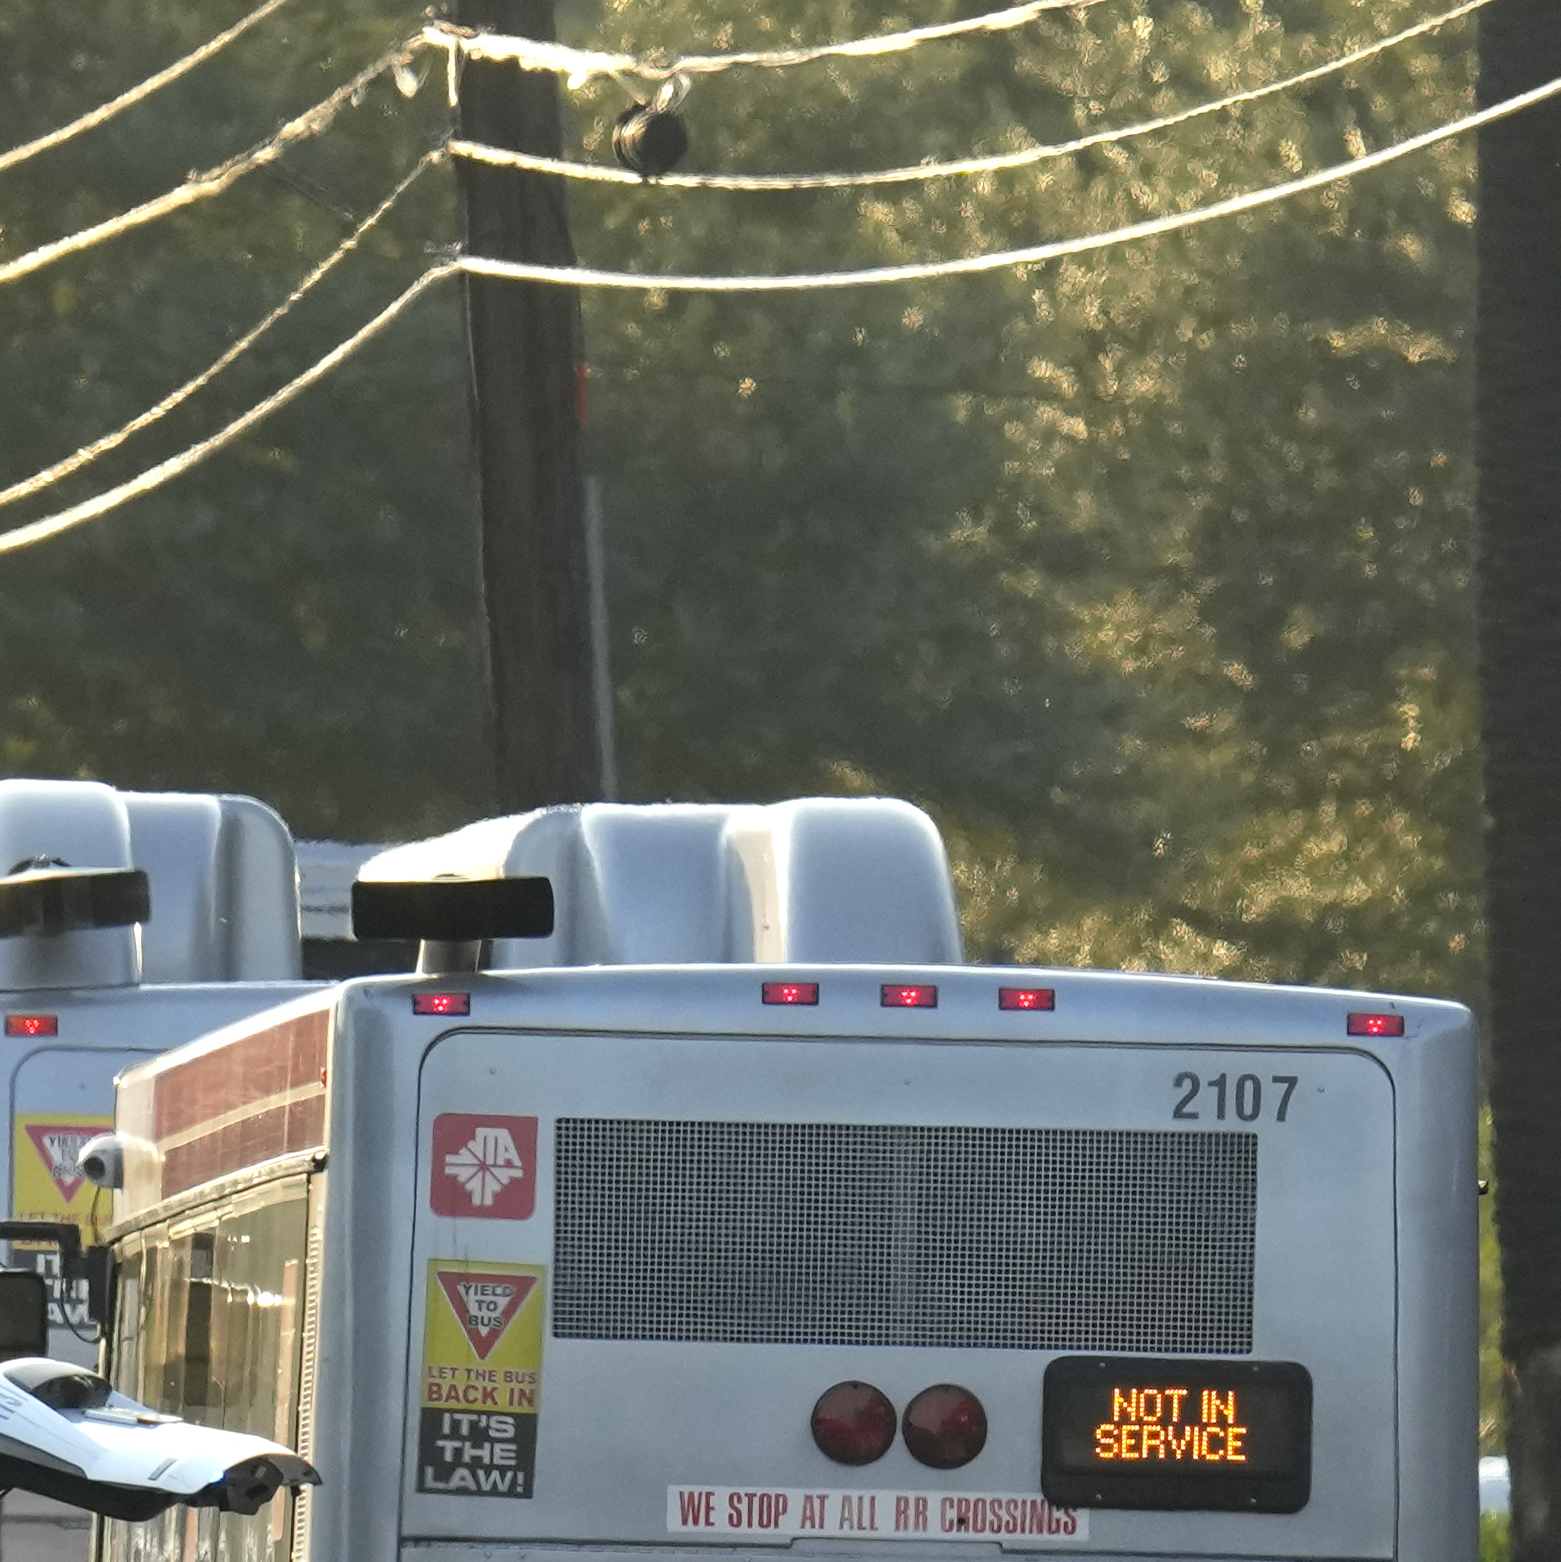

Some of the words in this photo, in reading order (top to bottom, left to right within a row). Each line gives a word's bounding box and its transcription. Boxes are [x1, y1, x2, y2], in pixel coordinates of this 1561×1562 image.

[1172, 1071, 1299, 1122] 2107
[462, 1283, 514, 1298] YIELD
[475, 1299, 498, 1312] TO
[468, 1314, 504, 1328] BUS
[427, 1365, 460, 1380] LET
[465, 1367, 498, 1383] THE
[503, 1370, 538, 1384] BUS
[427, 1382, 499, 1406] BACK
[508, 1387, 536, 1407] IN
[1111, 1386, 1189, 1423] NOT
[1201, 1389, 1236, 1425] IN
[442, 1412, 516, 1438] IT'S
[436, 1439, 518, 1466] THE
[1094, 1423, 1249, 1462] SERVICE
[424, 1465, 525, 1493] LAW!
[679, 1491, 715, 1528] WE
[727, 1491, 788, 1529] STOP
[800, 1493, 830, 1530] AT
[838, 1494, 879, 1531] ALL
[894, 1495, 929, 1532] RR
[940, 1497, 1078, 1536] CROSSINGS
